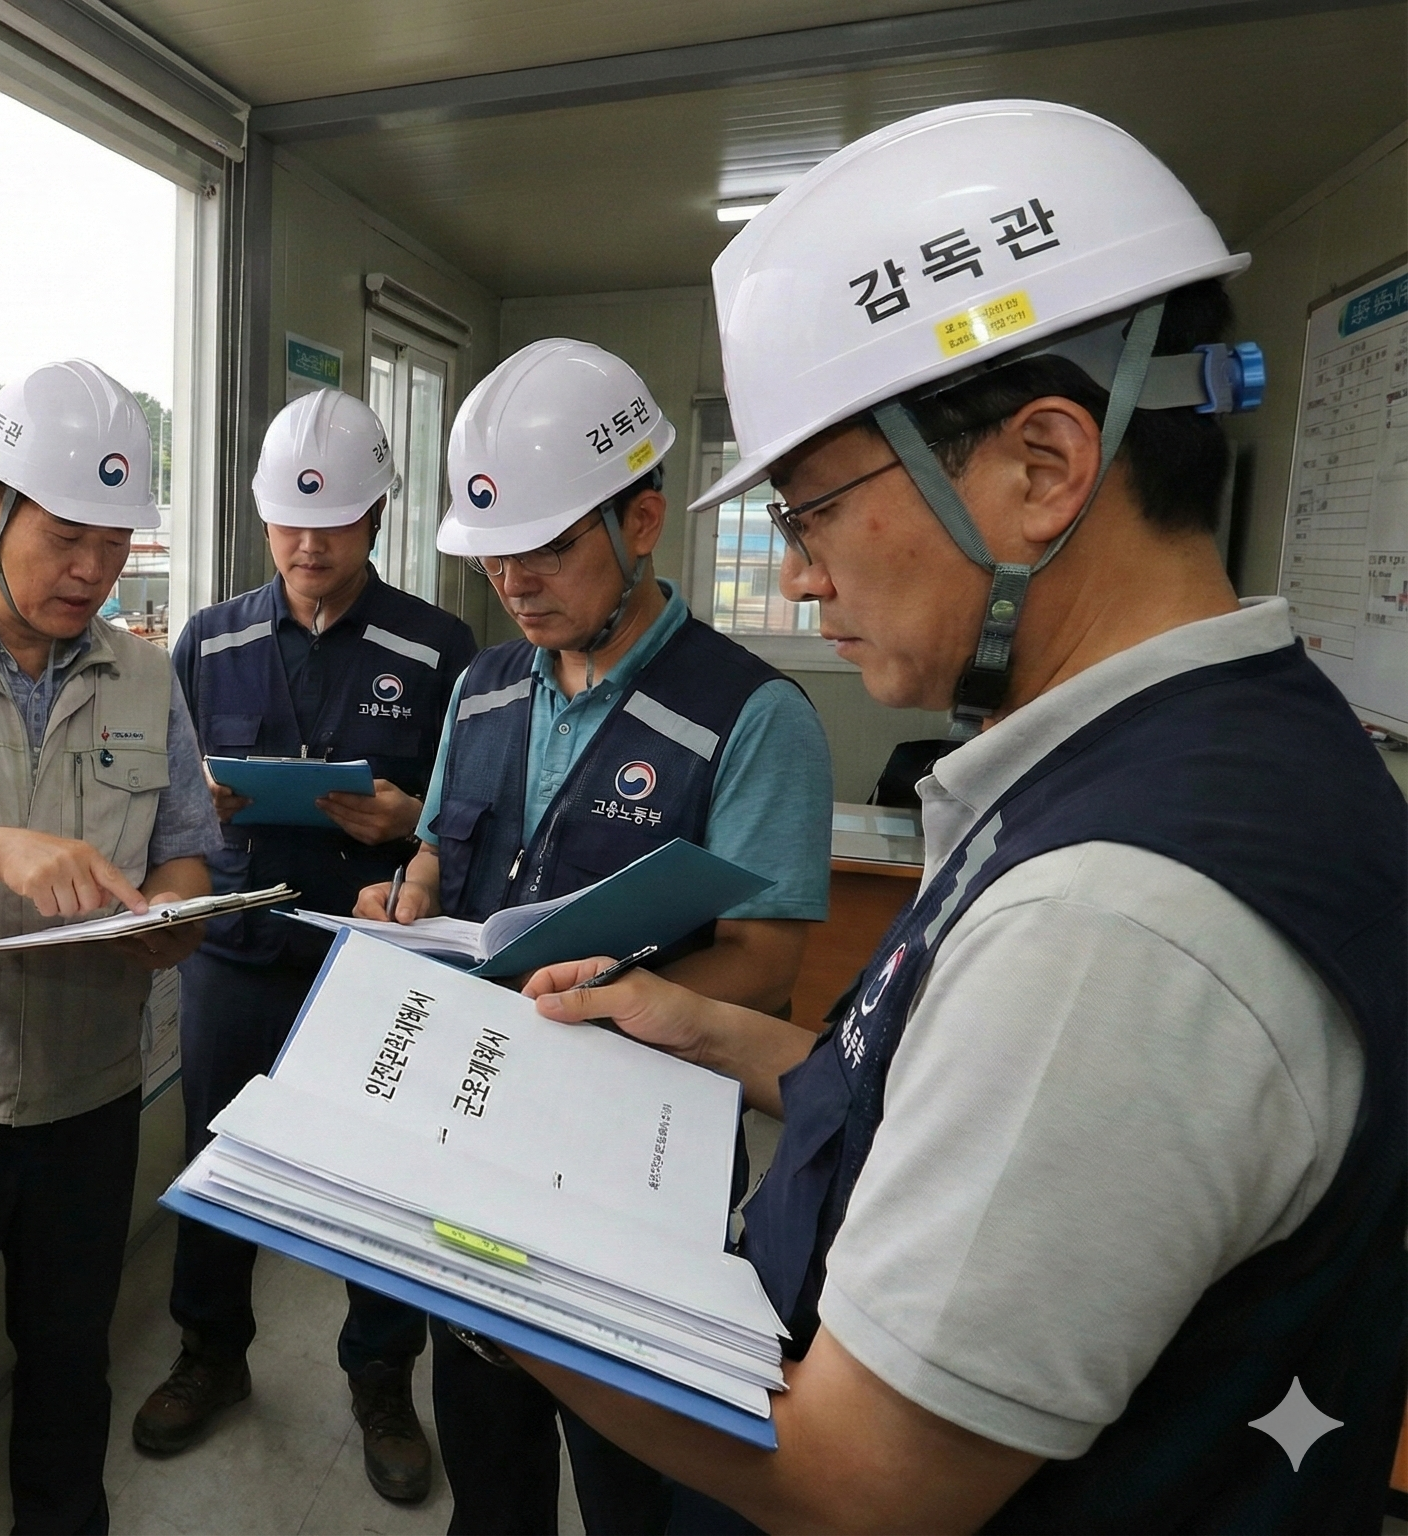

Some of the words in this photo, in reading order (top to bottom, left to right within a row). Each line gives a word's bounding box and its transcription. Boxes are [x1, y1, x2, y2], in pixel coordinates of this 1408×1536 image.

[849, 198, 1060, 325] 감독관
[586, 397, 650, 454] 감독관
[358, 703, 412, 720] 고용노동부
[591, 799, 662, 827] 고용노동부
